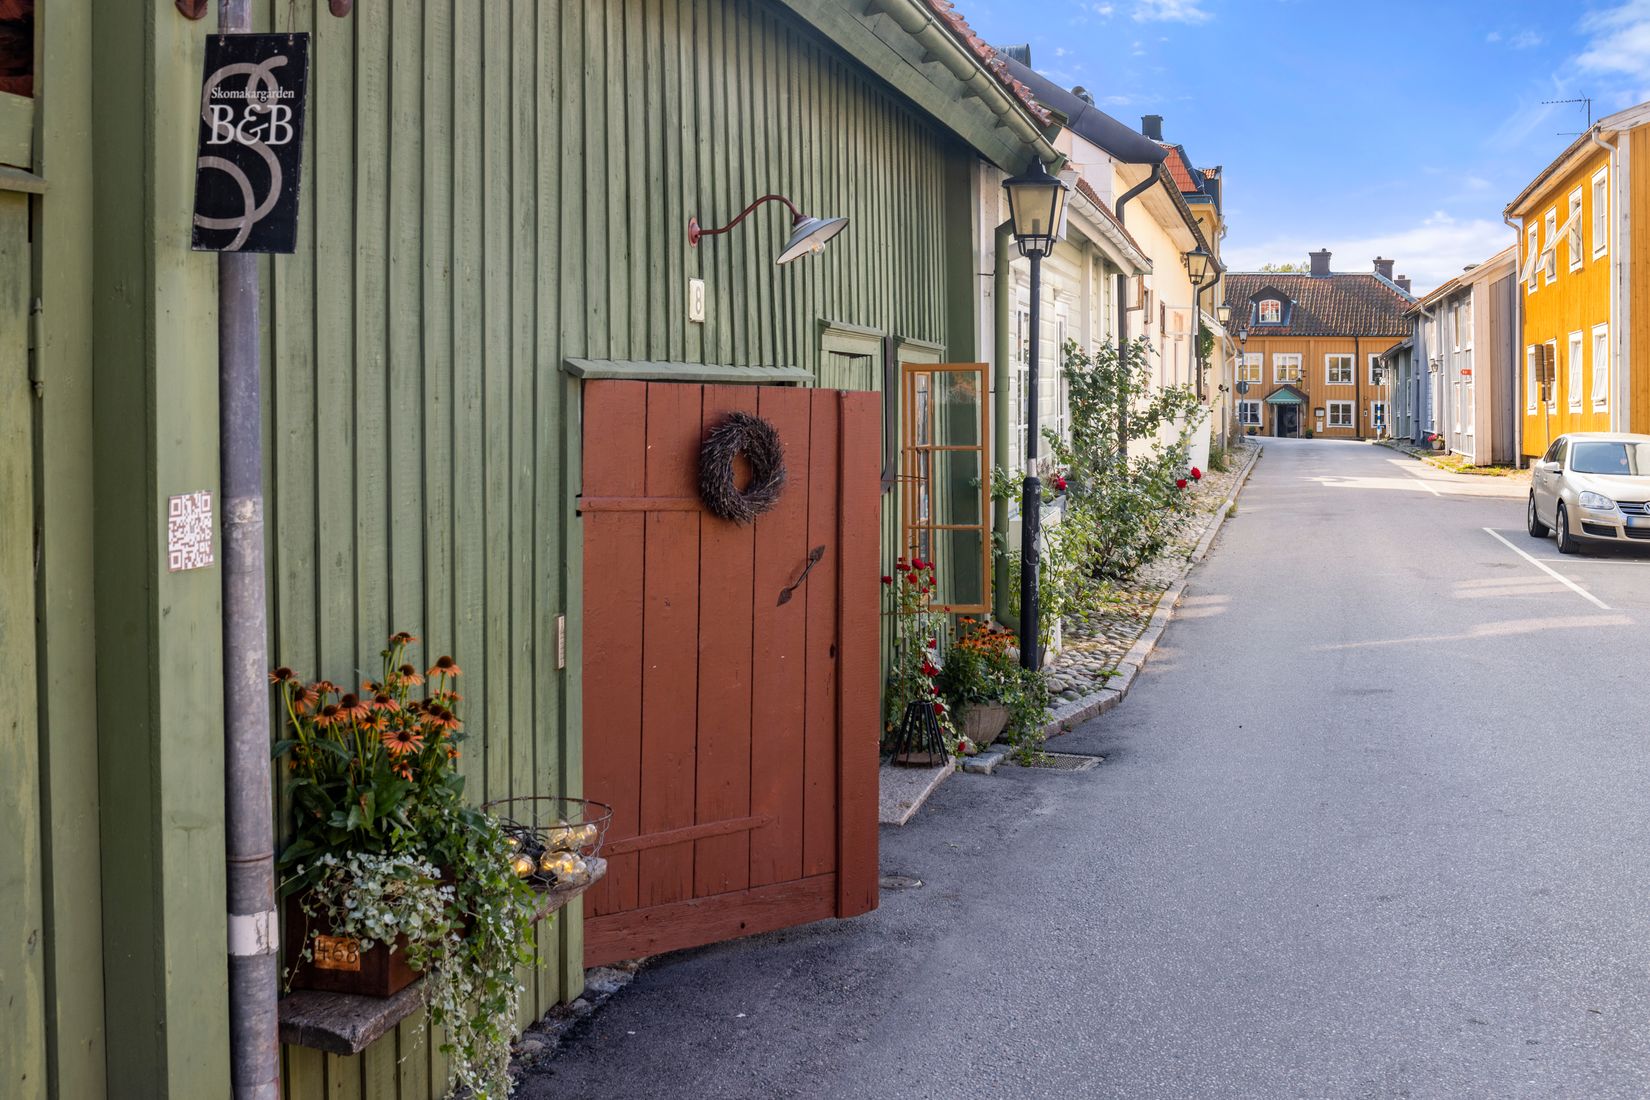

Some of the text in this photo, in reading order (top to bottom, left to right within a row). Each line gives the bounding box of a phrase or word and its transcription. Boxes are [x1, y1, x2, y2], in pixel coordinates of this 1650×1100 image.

[211, 86, 295, 102] Skomakargården
[206, 104, 294, 145] B&B
[695, 286, 702, 315] 8
[317, 938, 359, 964] 468
